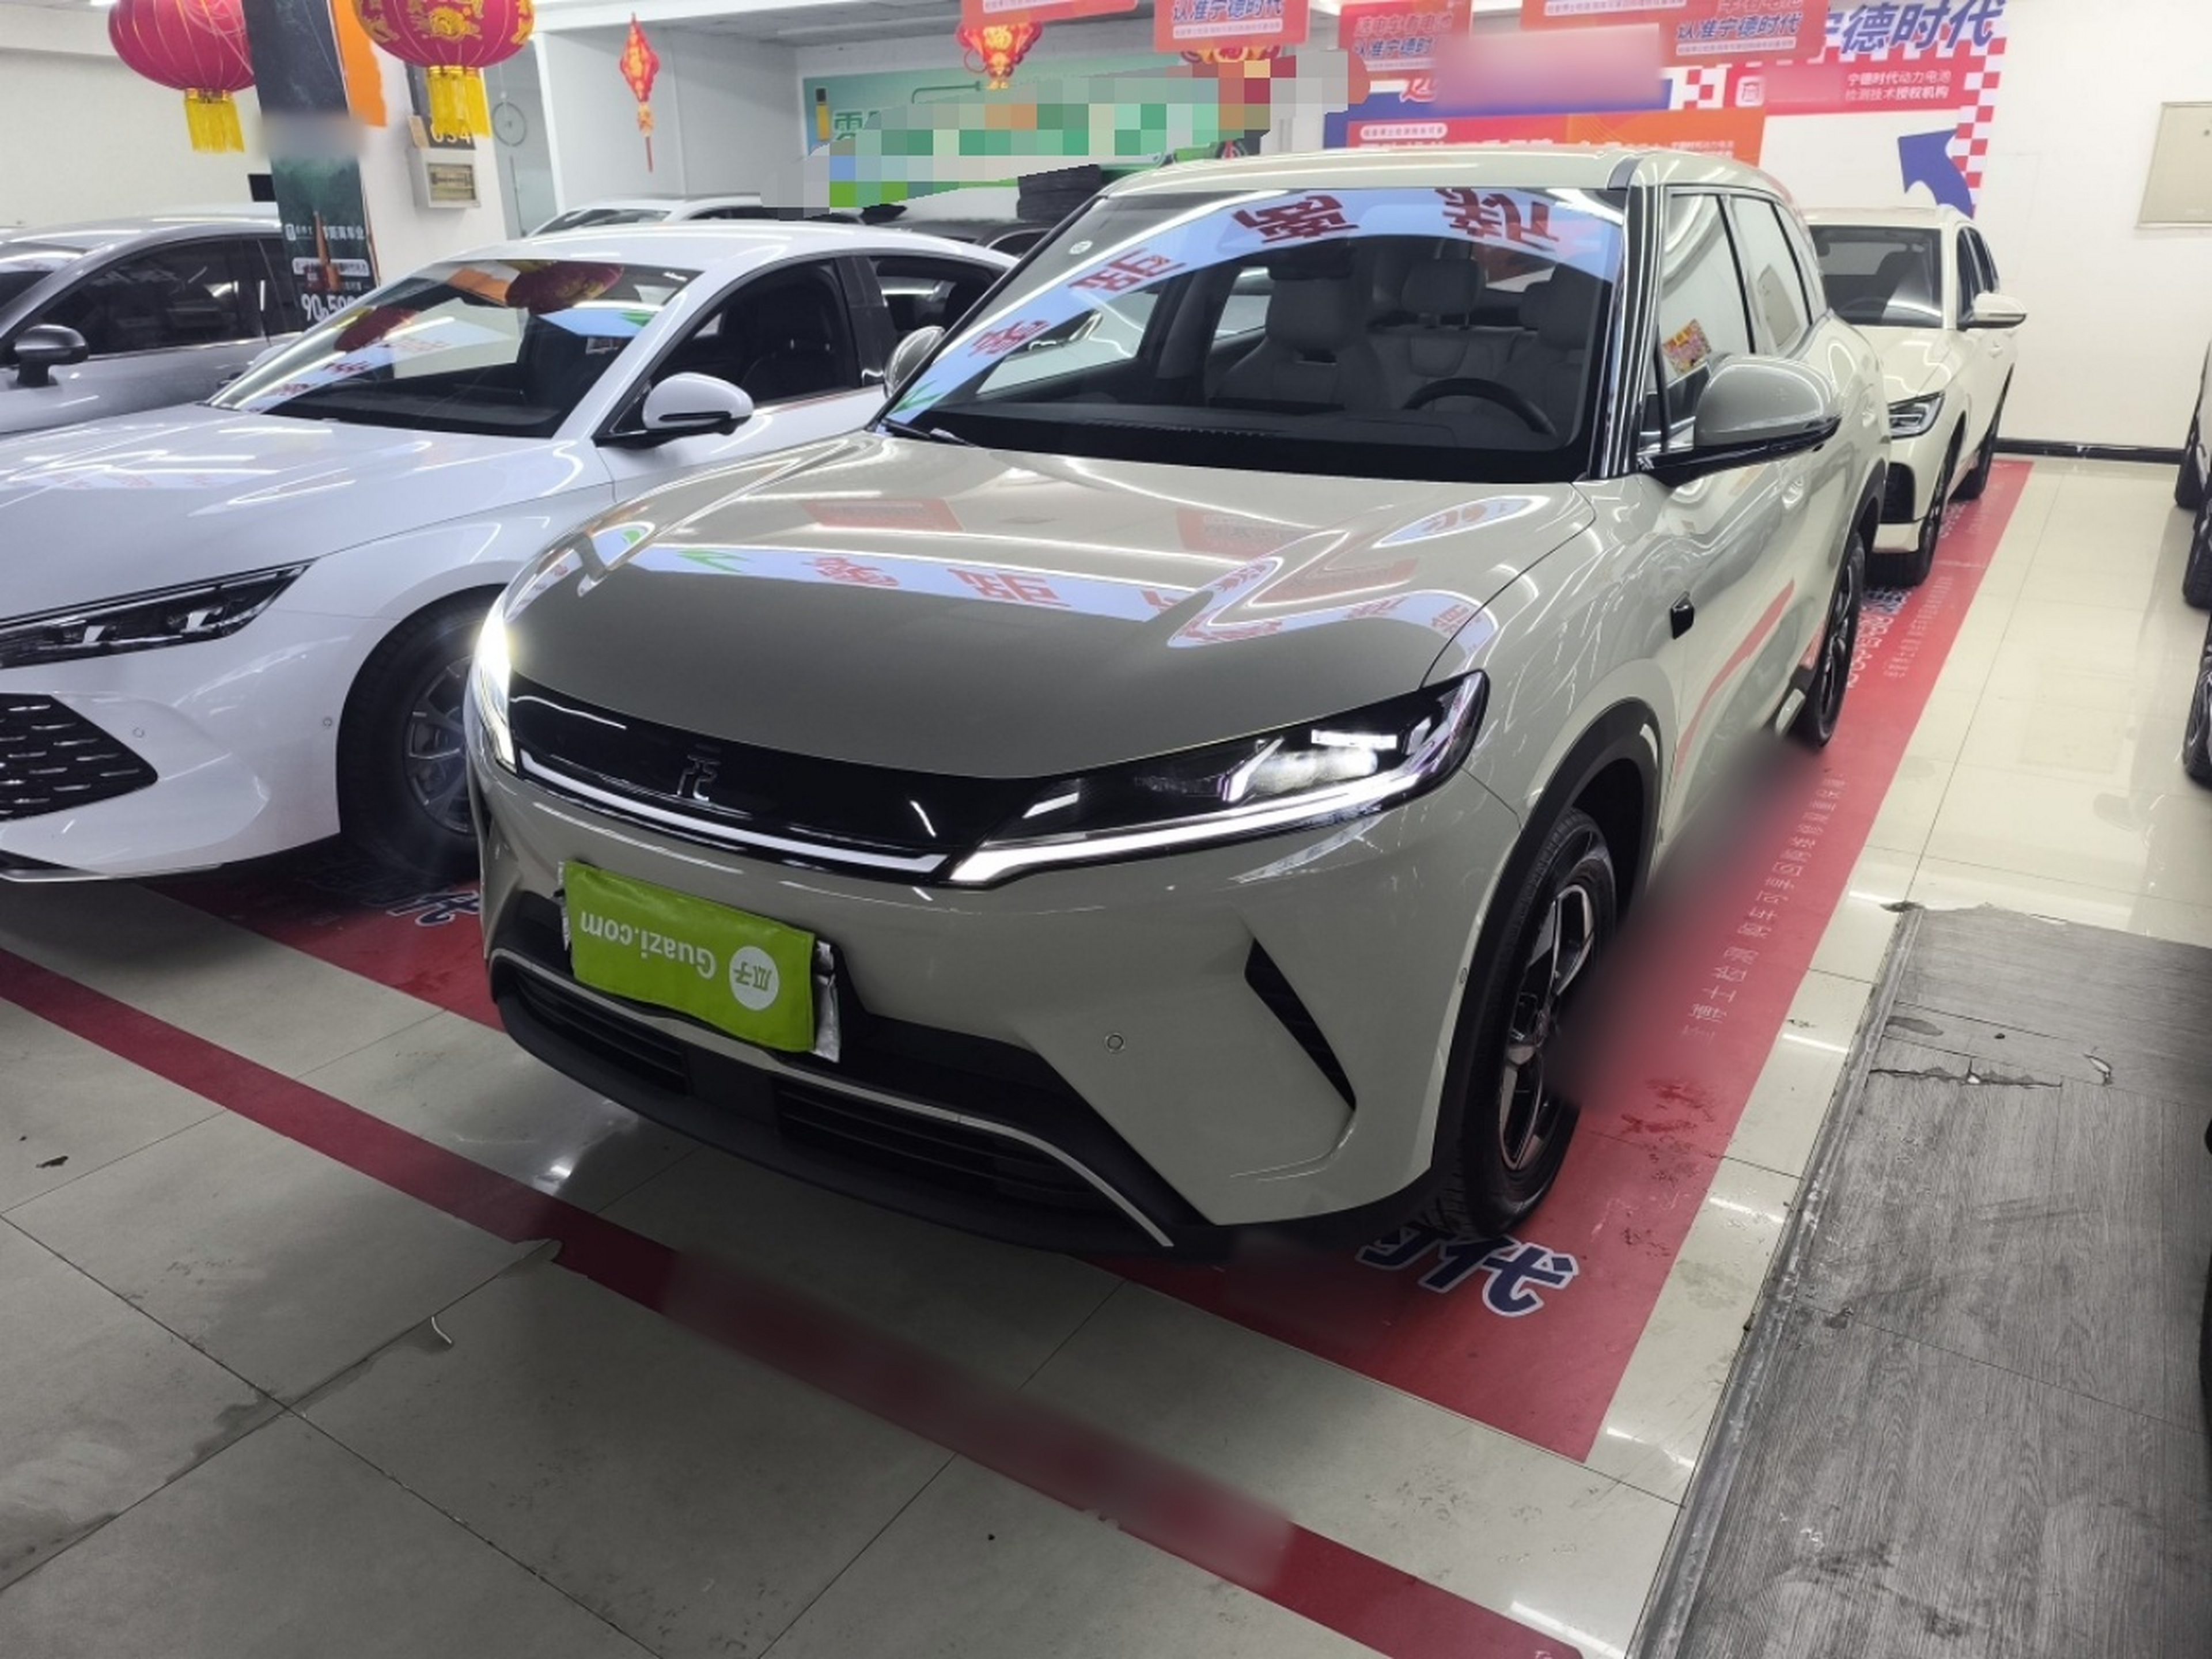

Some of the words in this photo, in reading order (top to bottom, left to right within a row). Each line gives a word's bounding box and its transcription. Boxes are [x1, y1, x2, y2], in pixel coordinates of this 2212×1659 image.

[1676, 13, 1802, 40] 认准宁德时代
[1354, 37, 1435, 58] 认准宁德时
[1847, 70, 1952, 86] 宁德时代动力电池
[1844, 85, 1949, 101] 检测技术授权机构
[580, 911, 717, 980] Guazi.com
[733, 961, 772, 993] 瓜子
